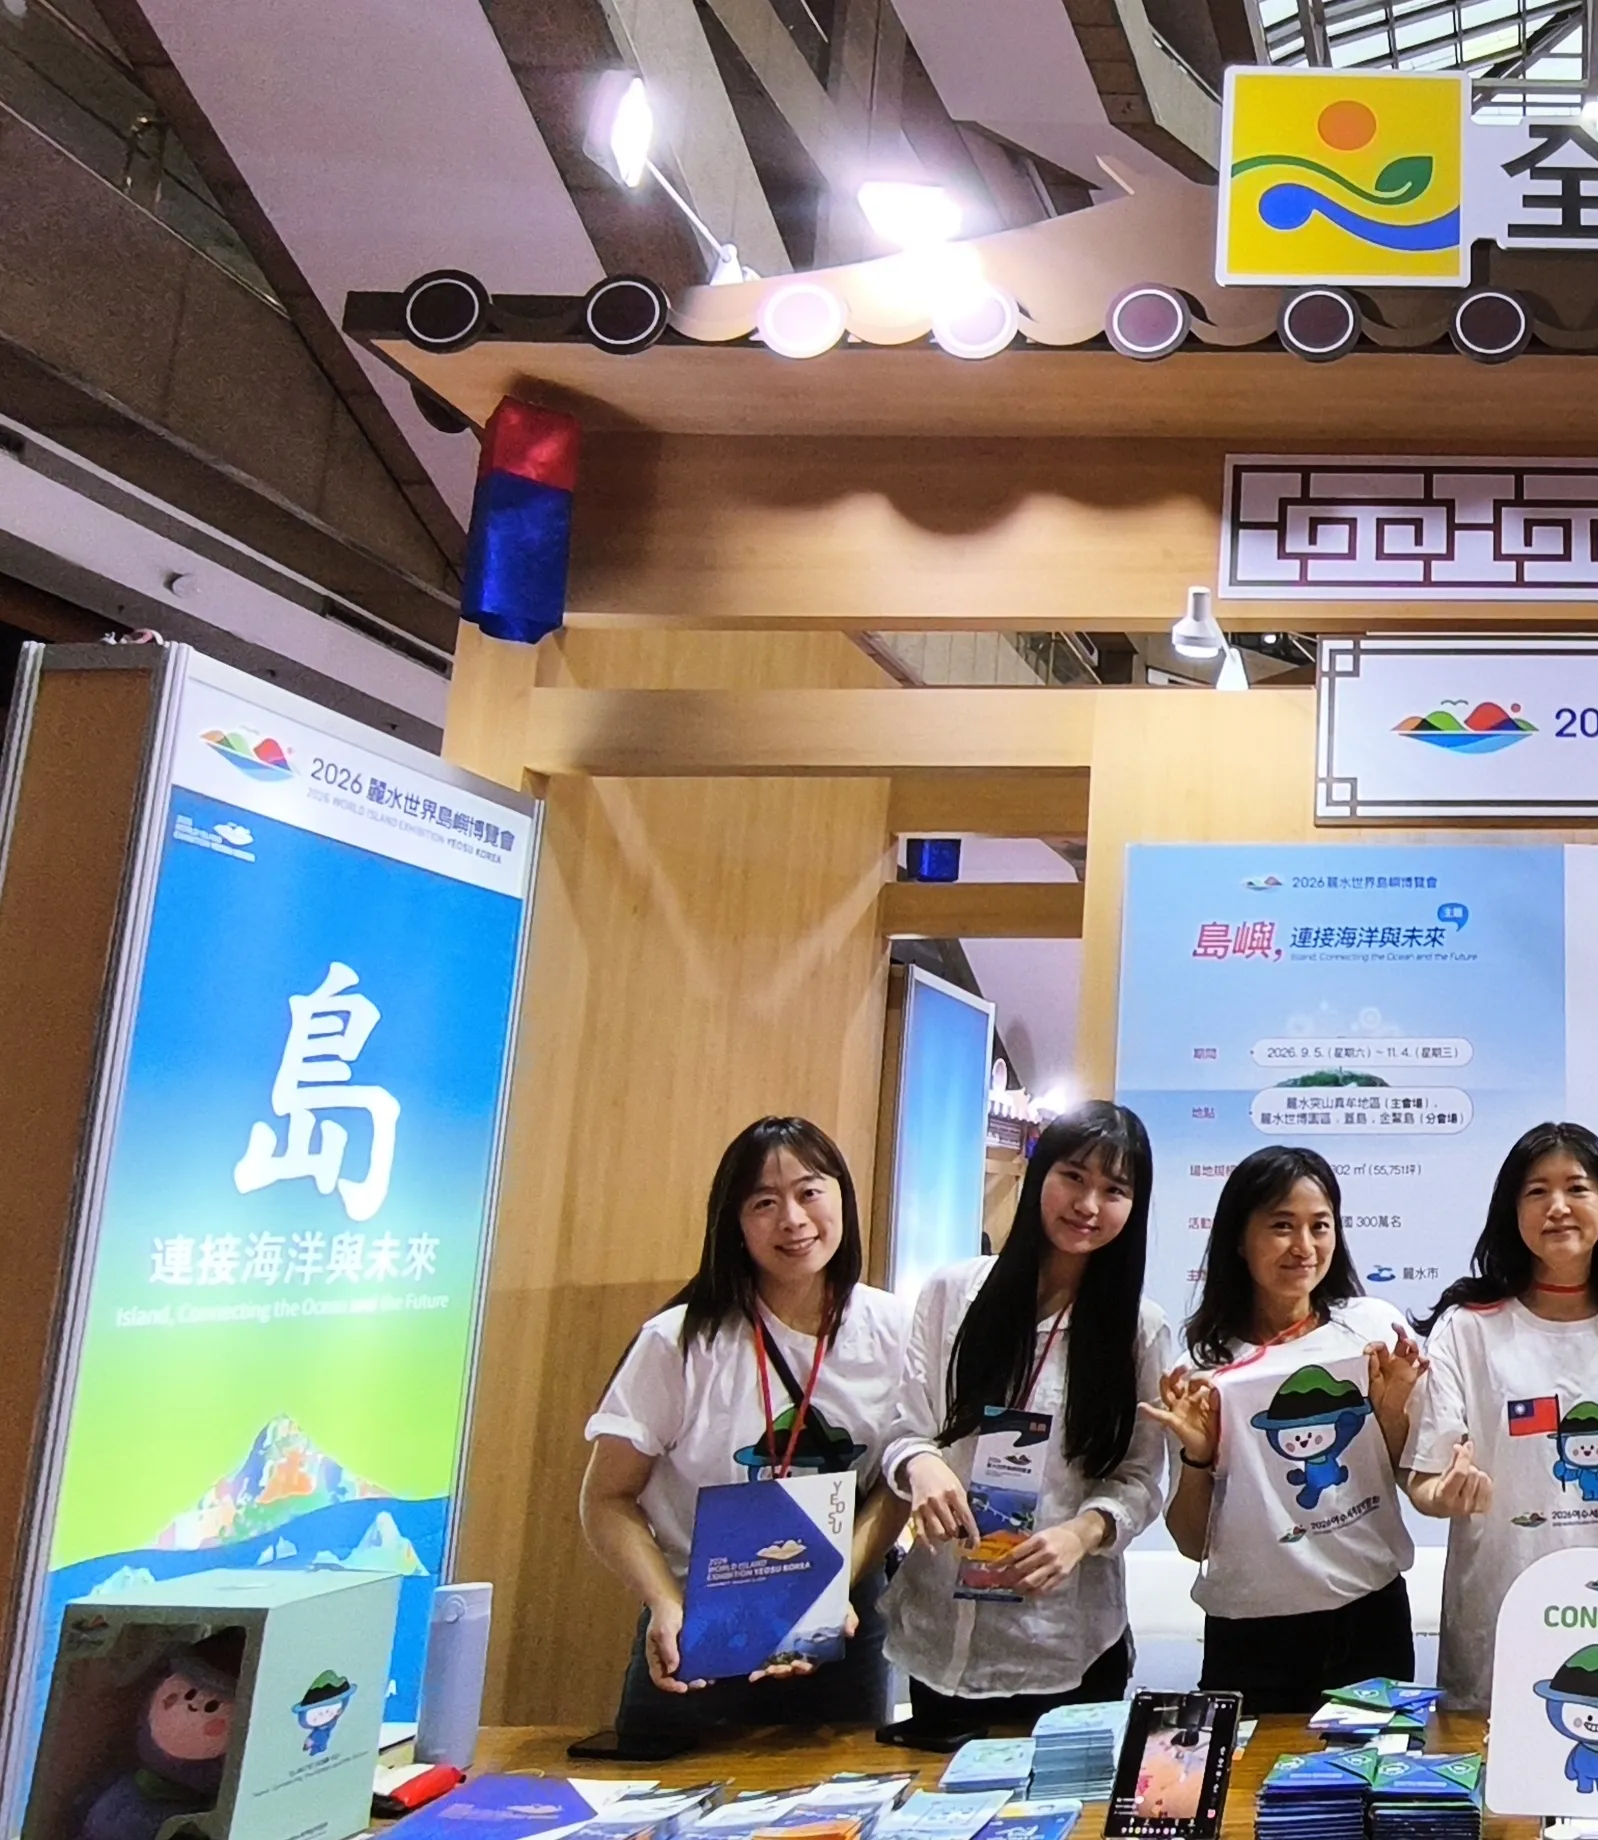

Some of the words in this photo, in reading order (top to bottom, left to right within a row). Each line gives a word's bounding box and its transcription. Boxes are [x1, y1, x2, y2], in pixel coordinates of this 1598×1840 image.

[475, 847, 502, 865] KOREA
[1289, 926, 1446, 949] 連接海洋與未來
[233, 960, 401, 1222] 島
[149, 1230, 440, 1286] 連接海洋與未來
[273, 1298, 298, 1318] the
[405, 1292, 449, 1310] Future
